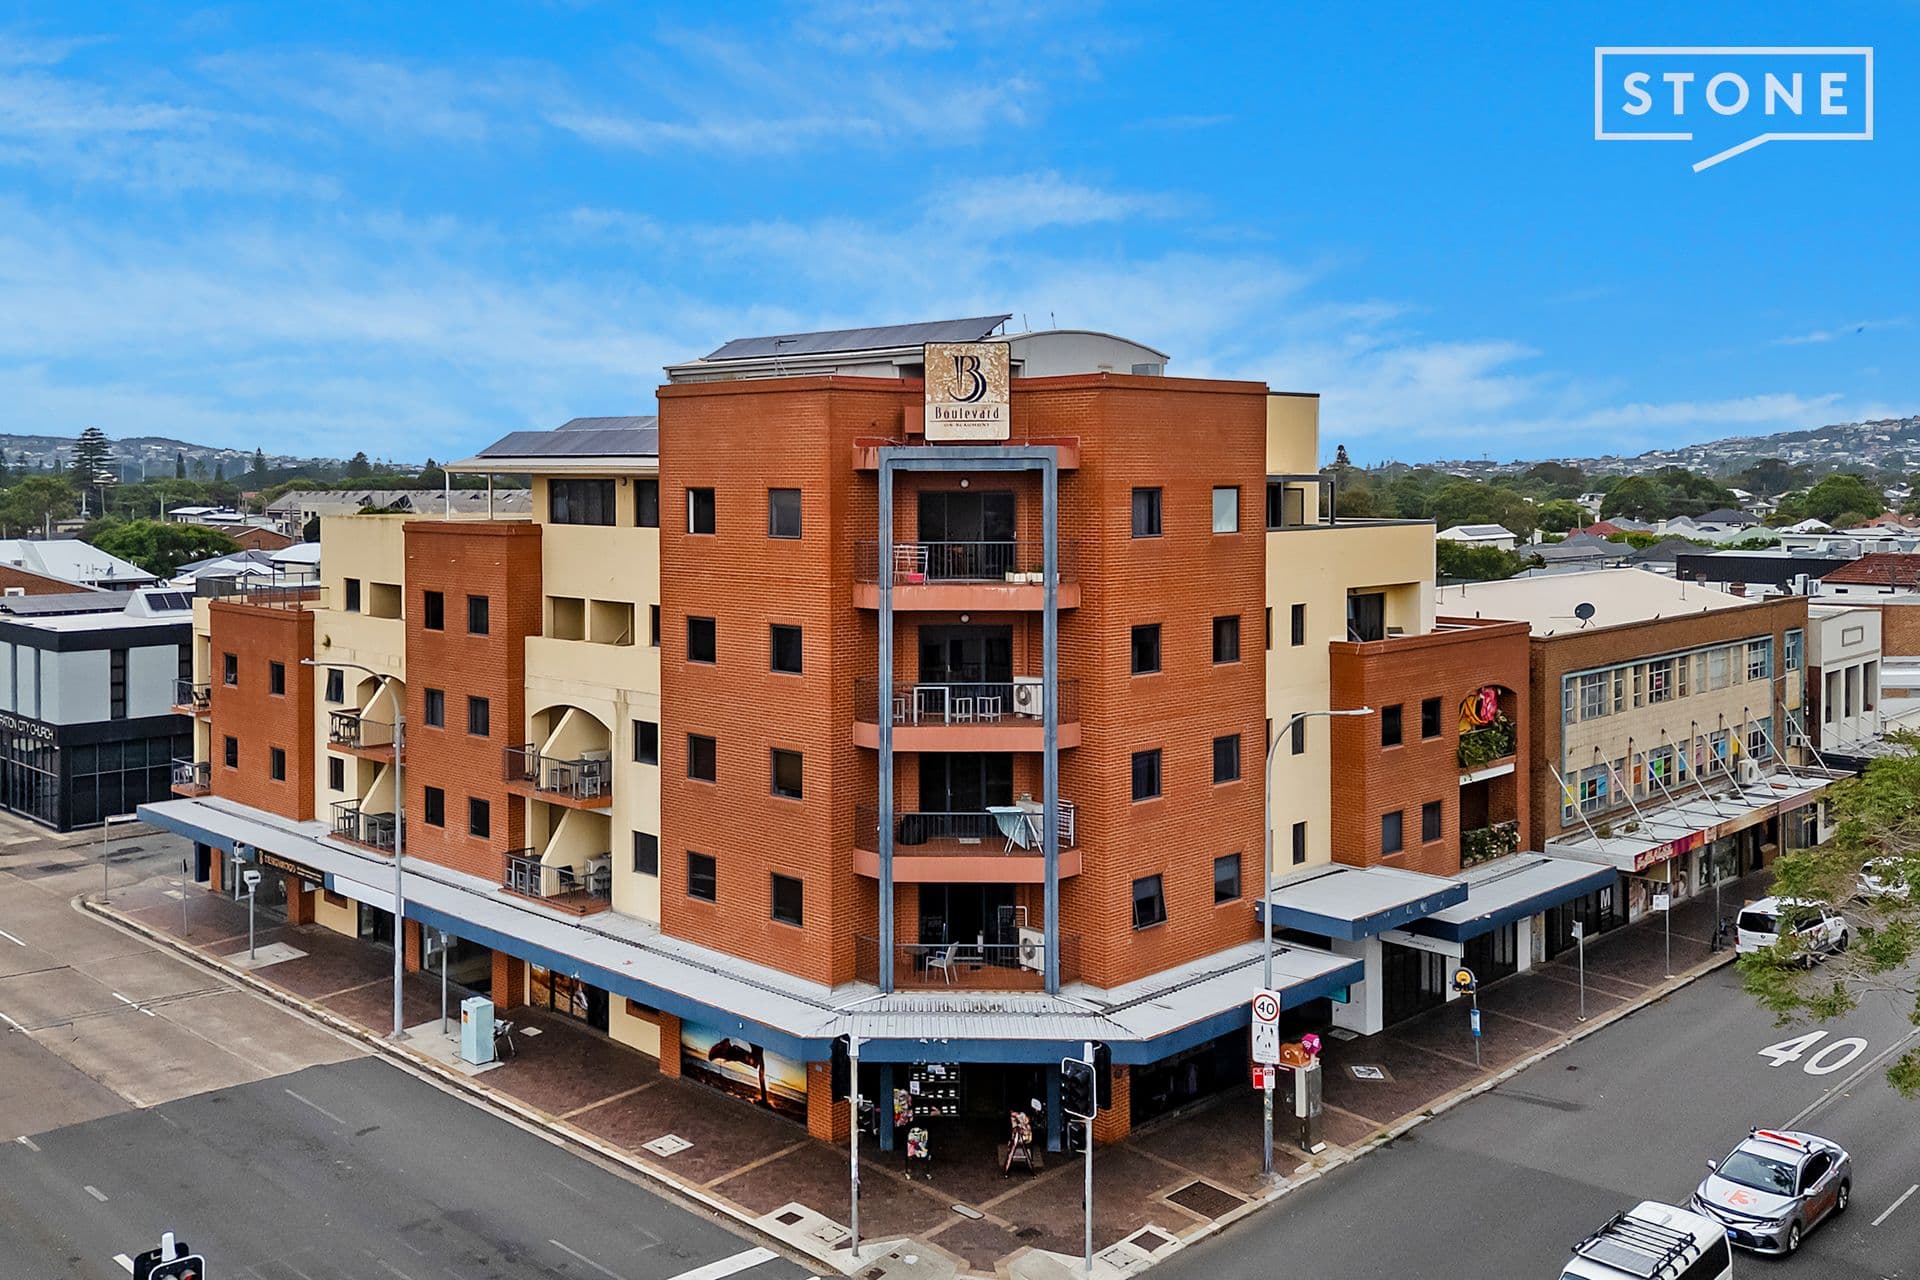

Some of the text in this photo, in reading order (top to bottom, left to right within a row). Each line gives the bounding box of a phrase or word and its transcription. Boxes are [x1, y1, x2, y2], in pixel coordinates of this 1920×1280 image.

[935, 406, 999, 420] Boulevard
[30, 723, 54, 740] CHURCH
[1257, 1001, 1275, 1015] 40
[1757, 1030, 1868, 1075] 40
